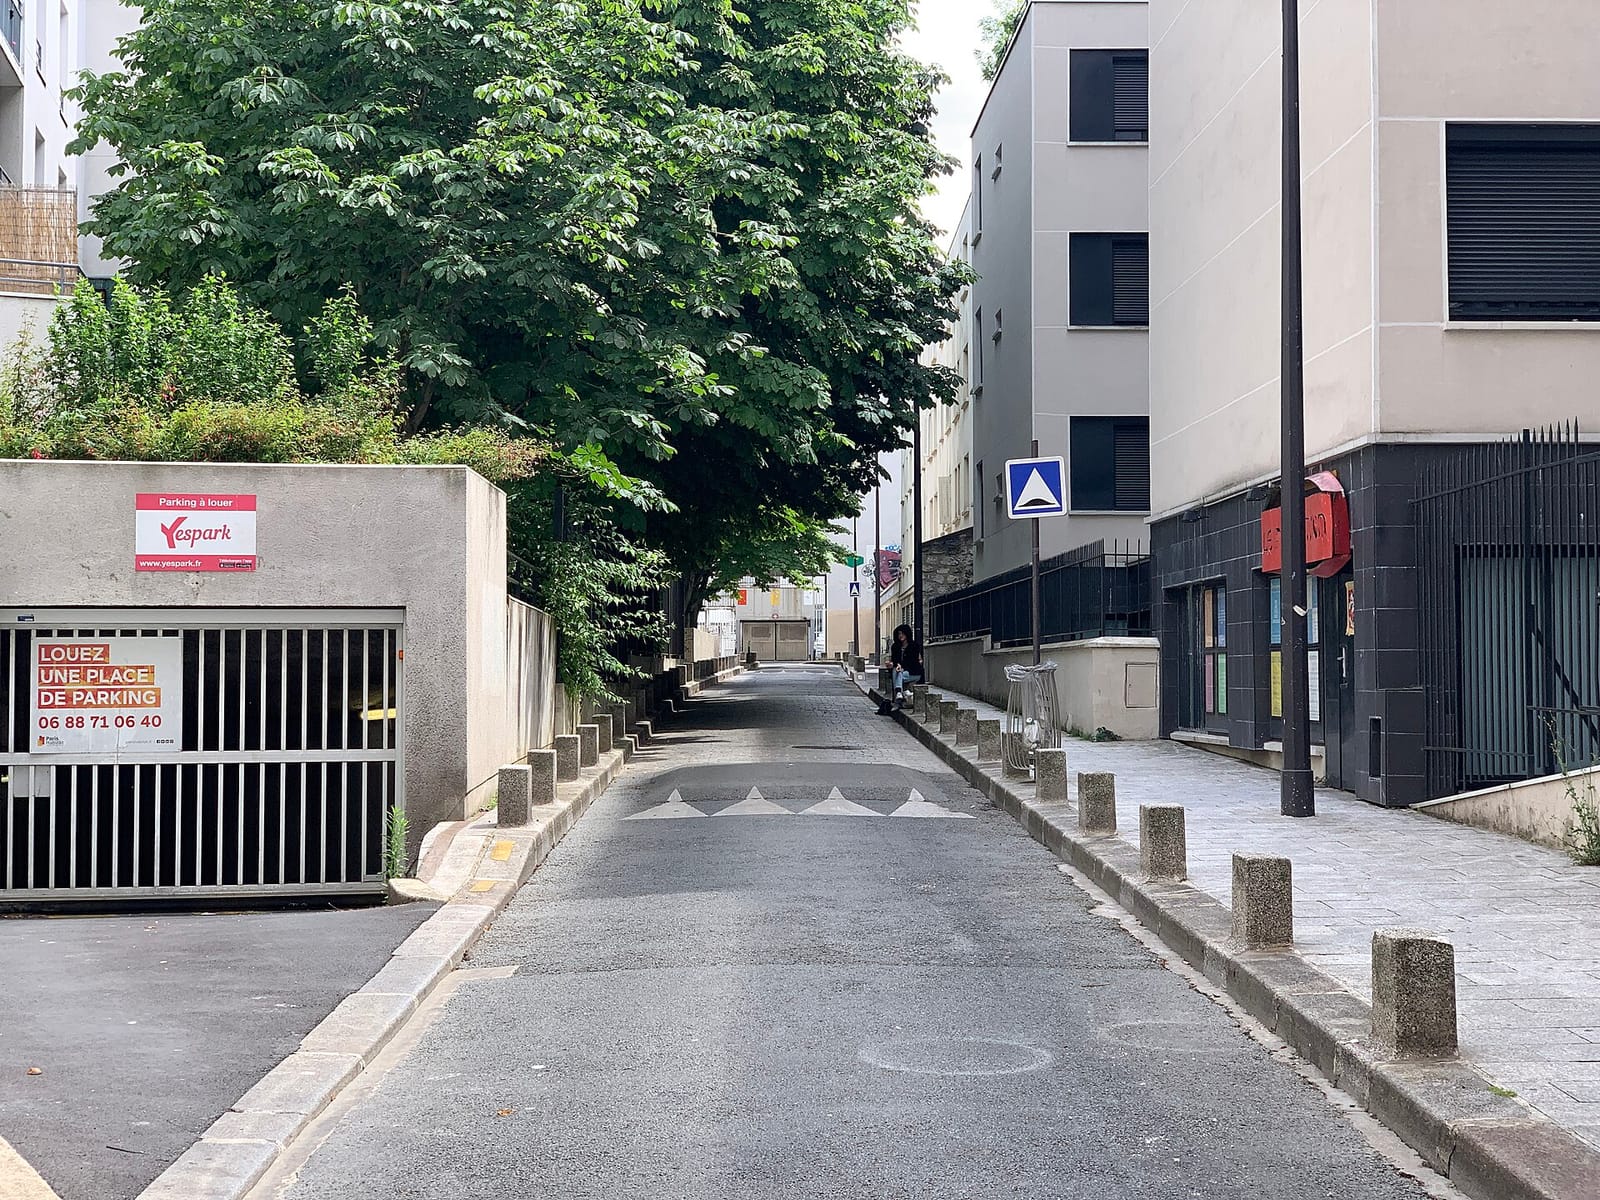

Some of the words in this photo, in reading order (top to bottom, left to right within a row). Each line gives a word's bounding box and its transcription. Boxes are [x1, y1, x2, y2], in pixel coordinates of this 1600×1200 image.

[159, 497, 196, 508] Parking
[199, 498, 205, 506] à
[208, 498, 233, 507] louer
[160, 516, 231, 548] Yespark
[140, 560, 202, 568] www.yespark.fr
[40, 647, 105, 662] LOUEZ
[40, 669, 81, 683] UNE
[86, 668, 149, 682] PLACE
[40, 691, 66, 706] DE
[72, 690, 157, 705] PARKING
[38, 716, 60, 729] 06
[65, 716, 85, 729] 88
[90, 716, 109, 728] 71
[114, 715, 136, 728] 06
[140, 715, 162, 728] 40
